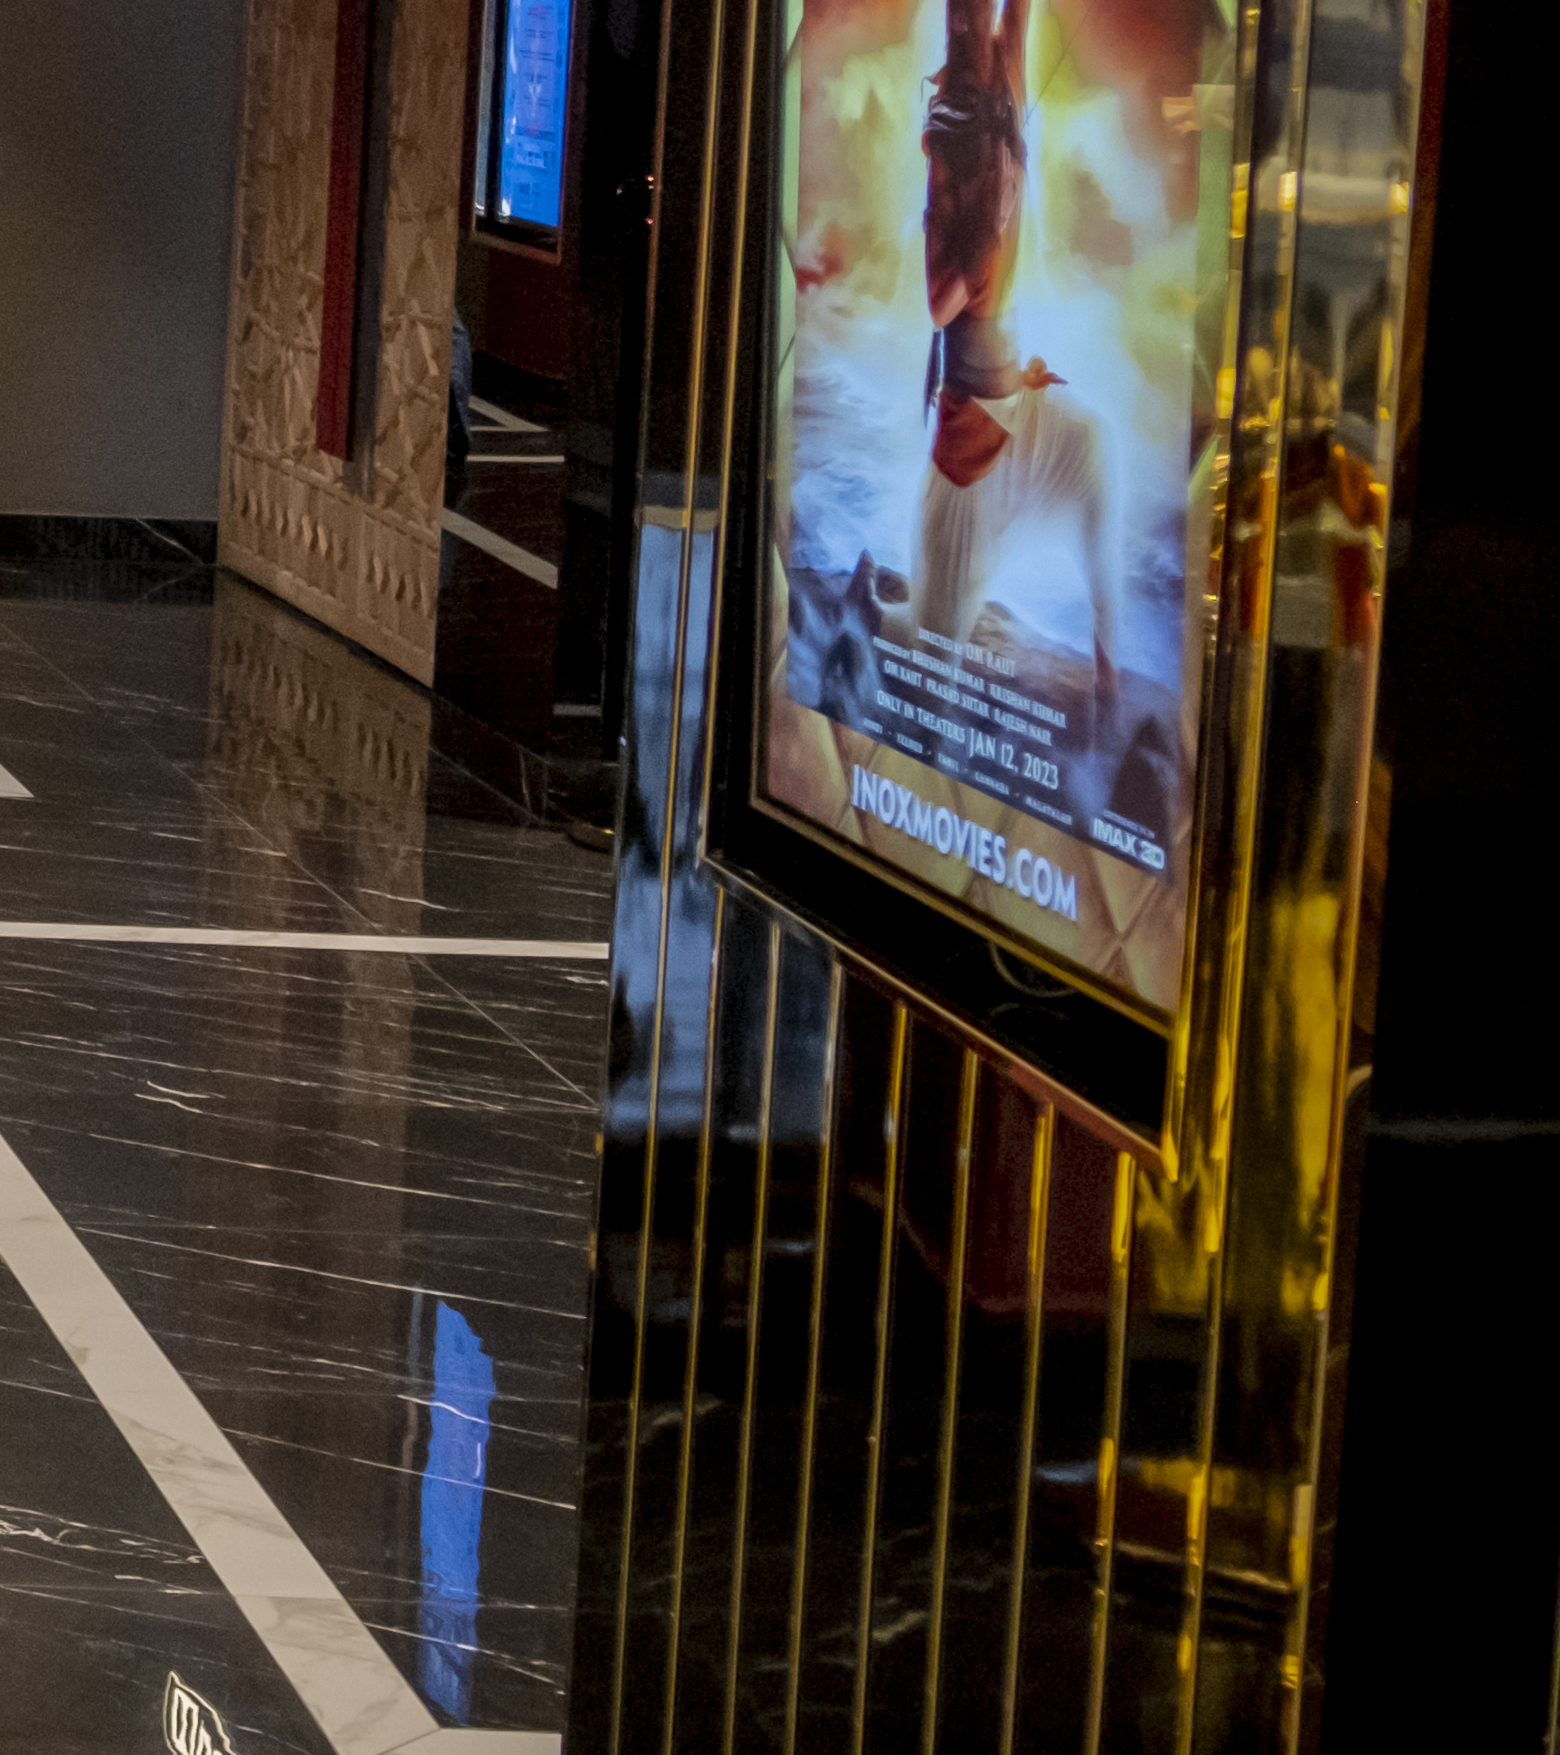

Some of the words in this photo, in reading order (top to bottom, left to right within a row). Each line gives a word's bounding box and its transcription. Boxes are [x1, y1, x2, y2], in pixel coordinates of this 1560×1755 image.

[877, 690, 902, 713] ONLY
[903, 704, 915, 720] IN
[969, 727, 997, 760] JAN
[1000, 742, 1019, 774] 12,
[1023, 752, 1059, 791] 2023
[851, 764, 1080, 922] INOXMOVIES.COM
[1092, 816, 1138, 858] IMAX
